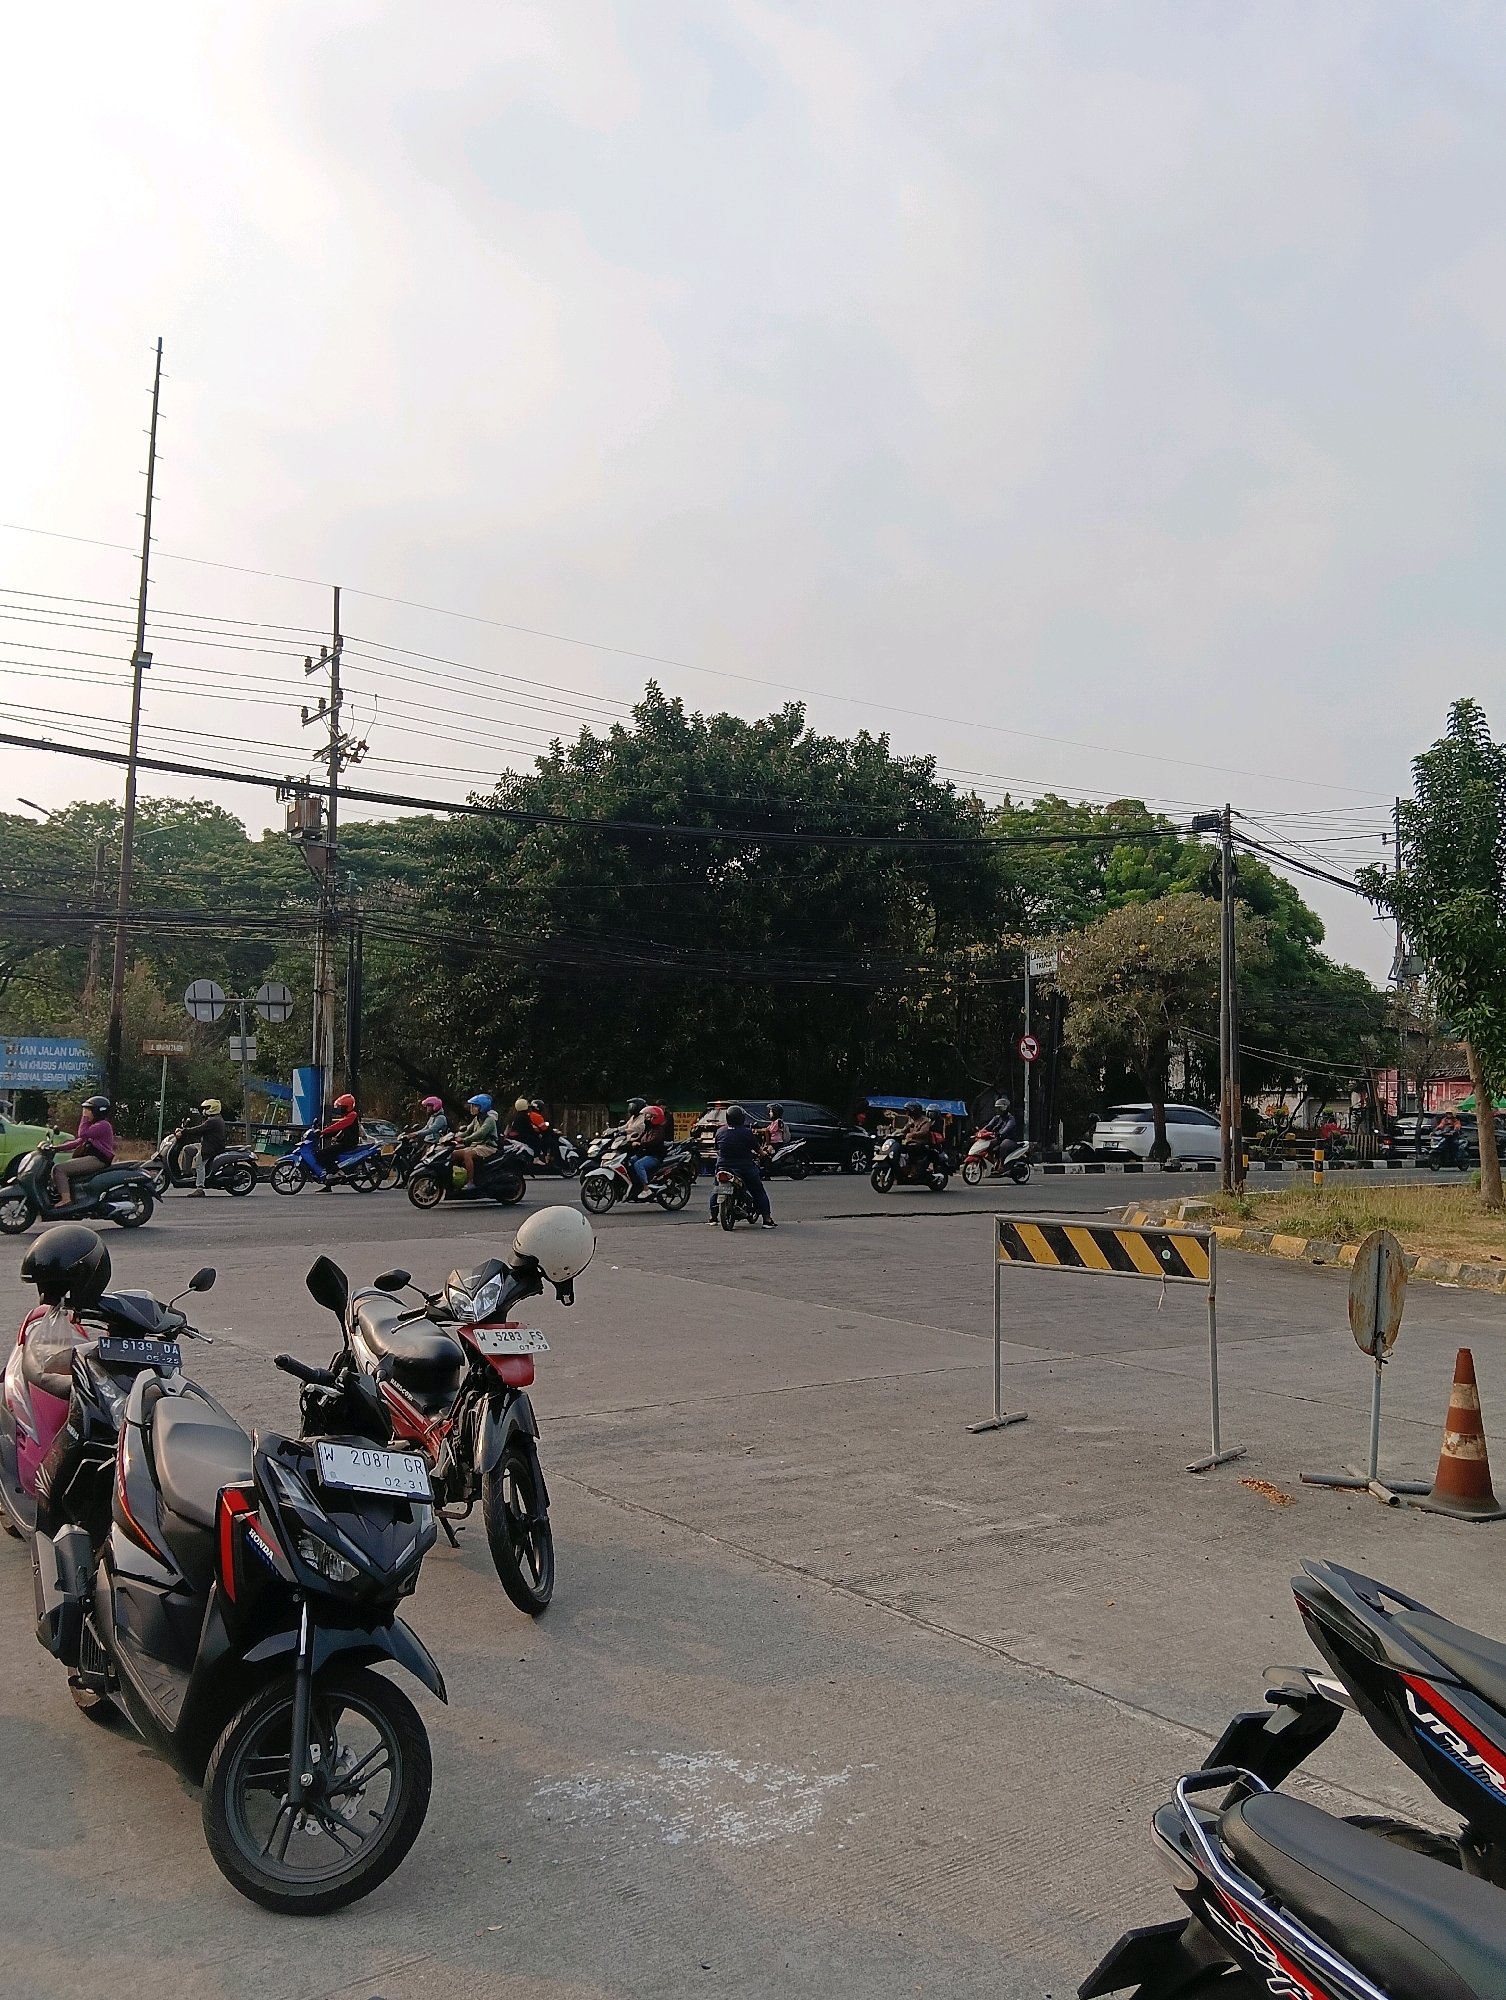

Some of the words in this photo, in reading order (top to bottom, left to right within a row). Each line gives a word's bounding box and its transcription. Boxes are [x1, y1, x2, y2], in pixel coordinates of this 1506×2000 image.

[38, 1046, 67, 1056] JALAN
[477, 1332, 486, 1342] W
[494, 1331, 522, 1342] 5283
[529, 1331, 544, 1341] FS
[101, 1339, 110, 1349] W
[122, 1340, 153, 1351] 6139
[164, 1344, 179, 1355] DA
[146, 1355, 179, 1365] 05-25
[324, 1447, 334, 1462] W
[350, 1450, 390, 1470] 2087
[403, 1458, 424, 1475] GR
[248, 1527, 274, 1561] HONDA
